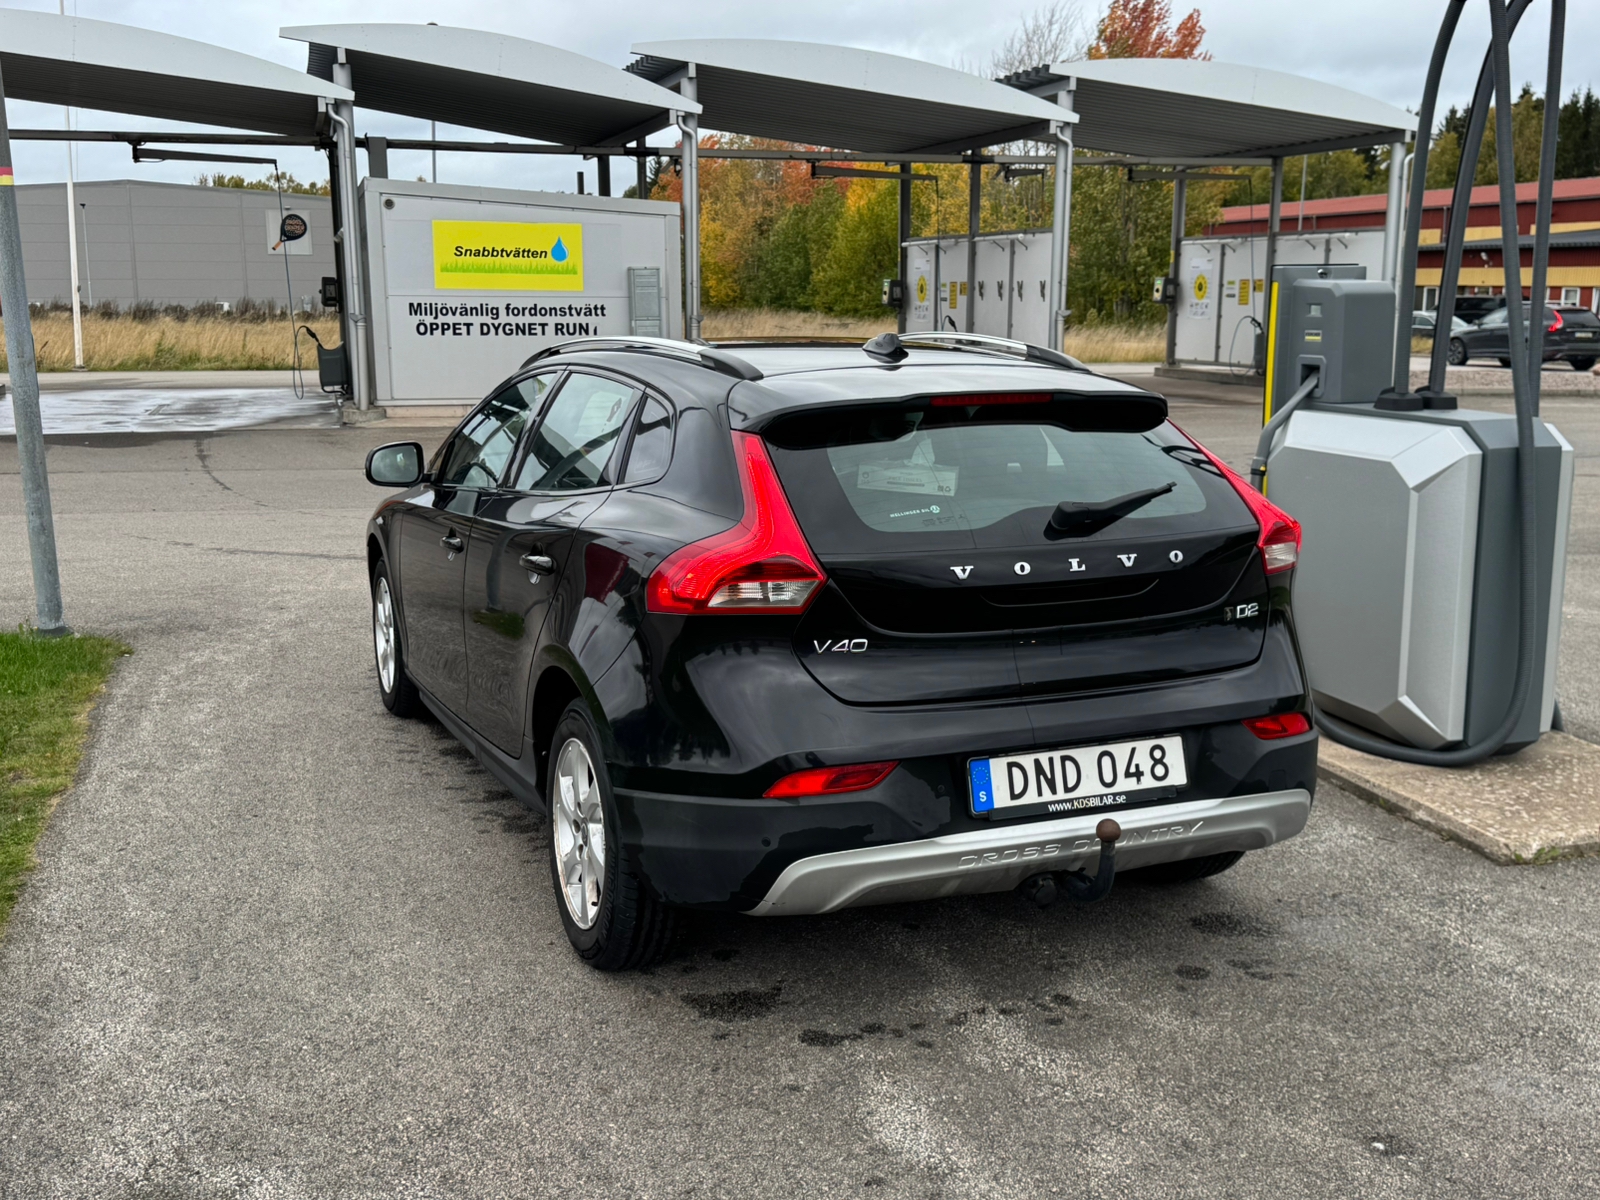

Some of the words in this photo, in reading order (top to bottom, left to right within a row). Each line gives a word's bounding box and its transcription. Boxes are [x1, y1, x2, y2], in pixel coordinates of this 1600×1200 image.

[454, 245, 548, 259] Snabbtvätten
[408, 302, 500, 320] Miljövänlig
[504, 302, 607, 318] fordonstvätt
[416, 319, 474, 336] ÖPPET
[479, 322, 550, 337] DYGNET
[949, 549, 1184, 581] VOLVO
[1236, 602, 1259, 619] D2
[813, 637, 868, 655] V40
[1006, 754, 1082, 801] DND
[1097, 743, 1170, 789] 048
[978, 790, 988, 803] S
[1048, 794, 1127, 813] www.KDSBILAR.se
[957, 843, 1062, 869] CROSS
